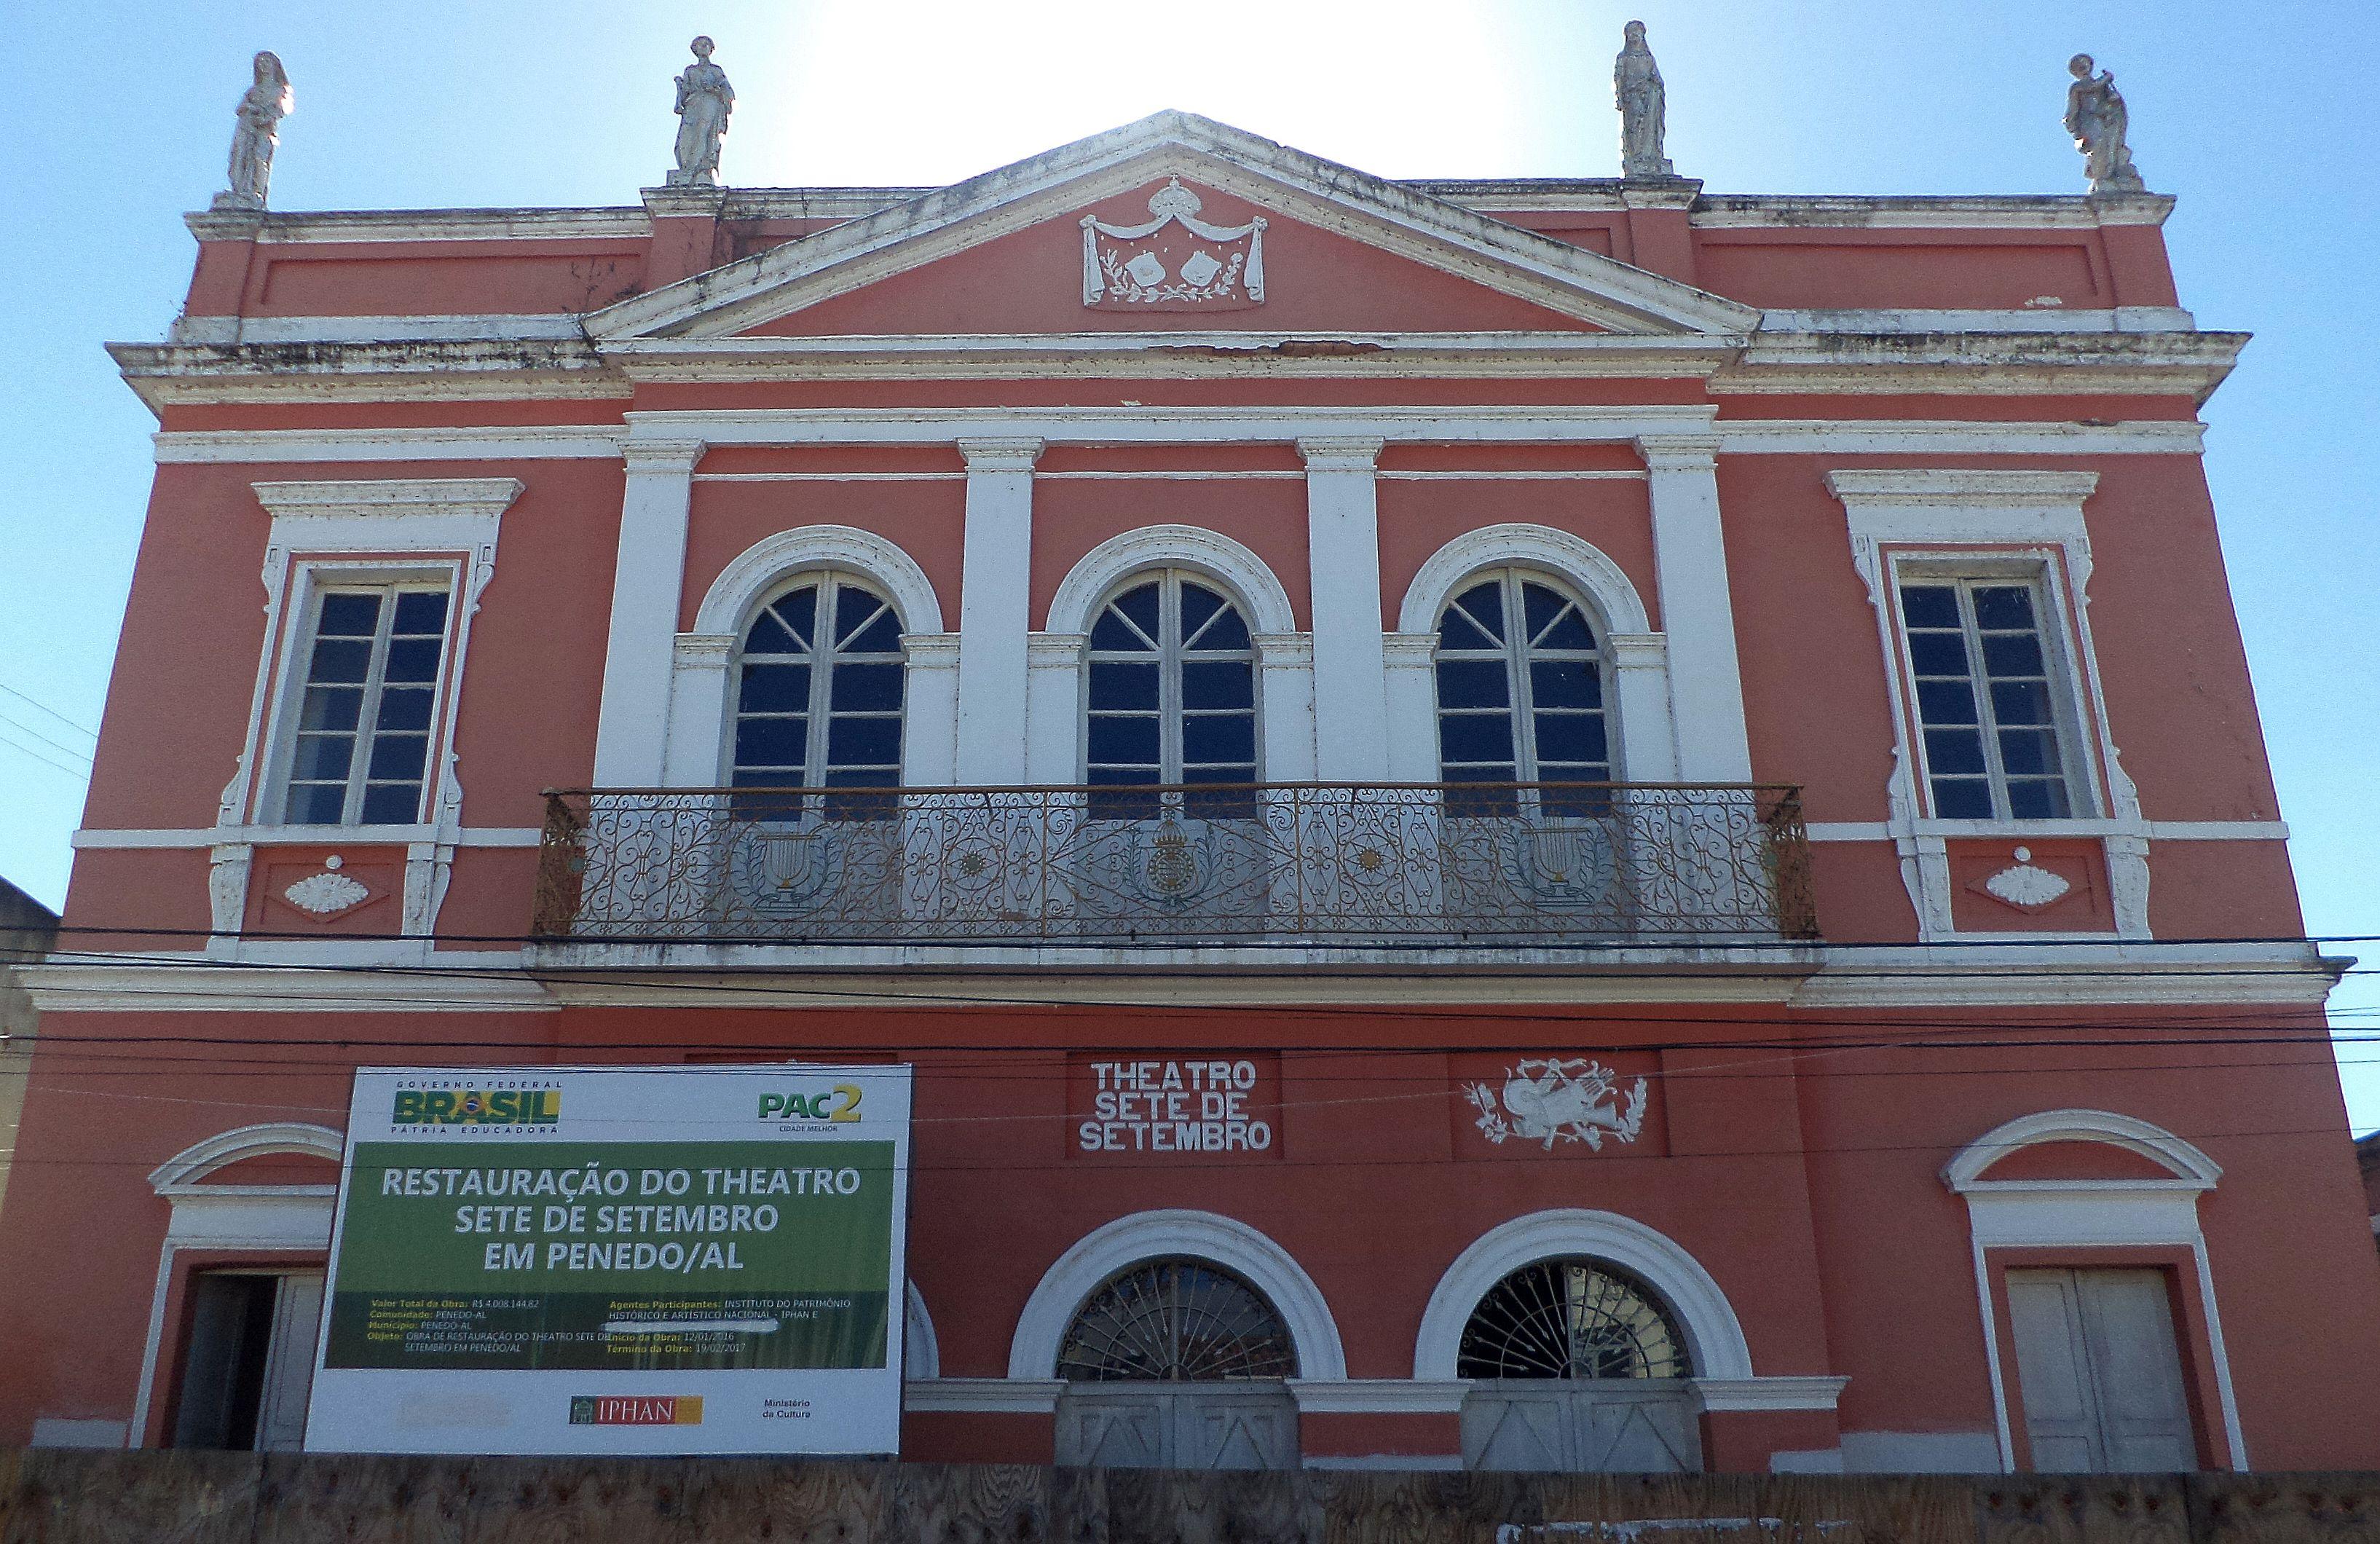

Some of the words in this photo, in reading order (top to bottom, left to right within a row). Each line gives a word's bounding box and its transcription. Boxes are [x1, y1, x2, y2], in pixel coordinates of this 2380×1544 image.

[1091, 1060, 1256, 1090] THEATRO
[396, 1081, 475, 1089] GOVERNO
[487, 1081, 561, 1089] FEDERAL
[392, 1090, 561, 1124] BRASIL
[758, 1084, 862, 1122] PAC2
[1095, 1092, 1189, 1121] SETE
[1202, 1092, 1250, 1120] DE
[391, 1126, 447, 1134] PÁTRIA
[461, 1126, 559, 1134] EDUCADORA
[1079, 1121, 1272, 1151] SETEMBRO
[382, 1161, 629, 1202] RESTAURAÇÃO
[640, 1167, 691, 1196] DO
[701, 1167, 861, 1195] THEATRO
[454, 1205, 533, 1232] SETE
[543, 1205, 586, 1232] DE
[596, 1204, 779, 1232] SETEMBRO
[484, 1242, 535, 1269] EM
[547, 1242, 744, 1274] PENEDO/AL
[371, 1299, 395, 1308] Valor
[400, 1299, 423, 1308] Total
[427, 1299, 438, 1308] da
[472, 1299, 483, 1309] R$
[610, 1301, 650, 1310] Agentes
[653, 1300, 722, 1310] Participantes:
[725, 1299, 774, 1308] INSTITUTO
[776, 1299, 790, 1308] DO
[793, 1298, 851, 1308] PATRIMÔNIO
[609, 1310, 660, 1319] HISTÓRICO
[671, 1310, 721, 1319] ARTÍSTICO
[813, 1310, 818, 1318] E
[406, 1332, 430, 1340] OBRA
[433, 1332, 446, 1340] DE
[447, 1331, 512, 1342] RESTAURAÇÃO
[515, 1332, 529, 1341] DO
[532, 1332, 573, 1341] THEATRO
[575, 1332, 594, 1341] SETE
[639, 1333, 650, 1342] da
[653, 1333, 680, 1342] Obra:
[405, 1343, 452, 1352] SETEMBRO
[454, 1343, 467, 1352] EM
[470, 1343, 521, 1352] PENEDO/AL
[650, 1344, 661, 1353] da
[665, 1344, 693, 1353] Obra:
[764, 1398, 811, 1407] Ministério
[599, 1401, 674, 1420] IPHAN
[763, 1410, 773, 1418] da
[776, 1410, 811, 1418] Cultura
